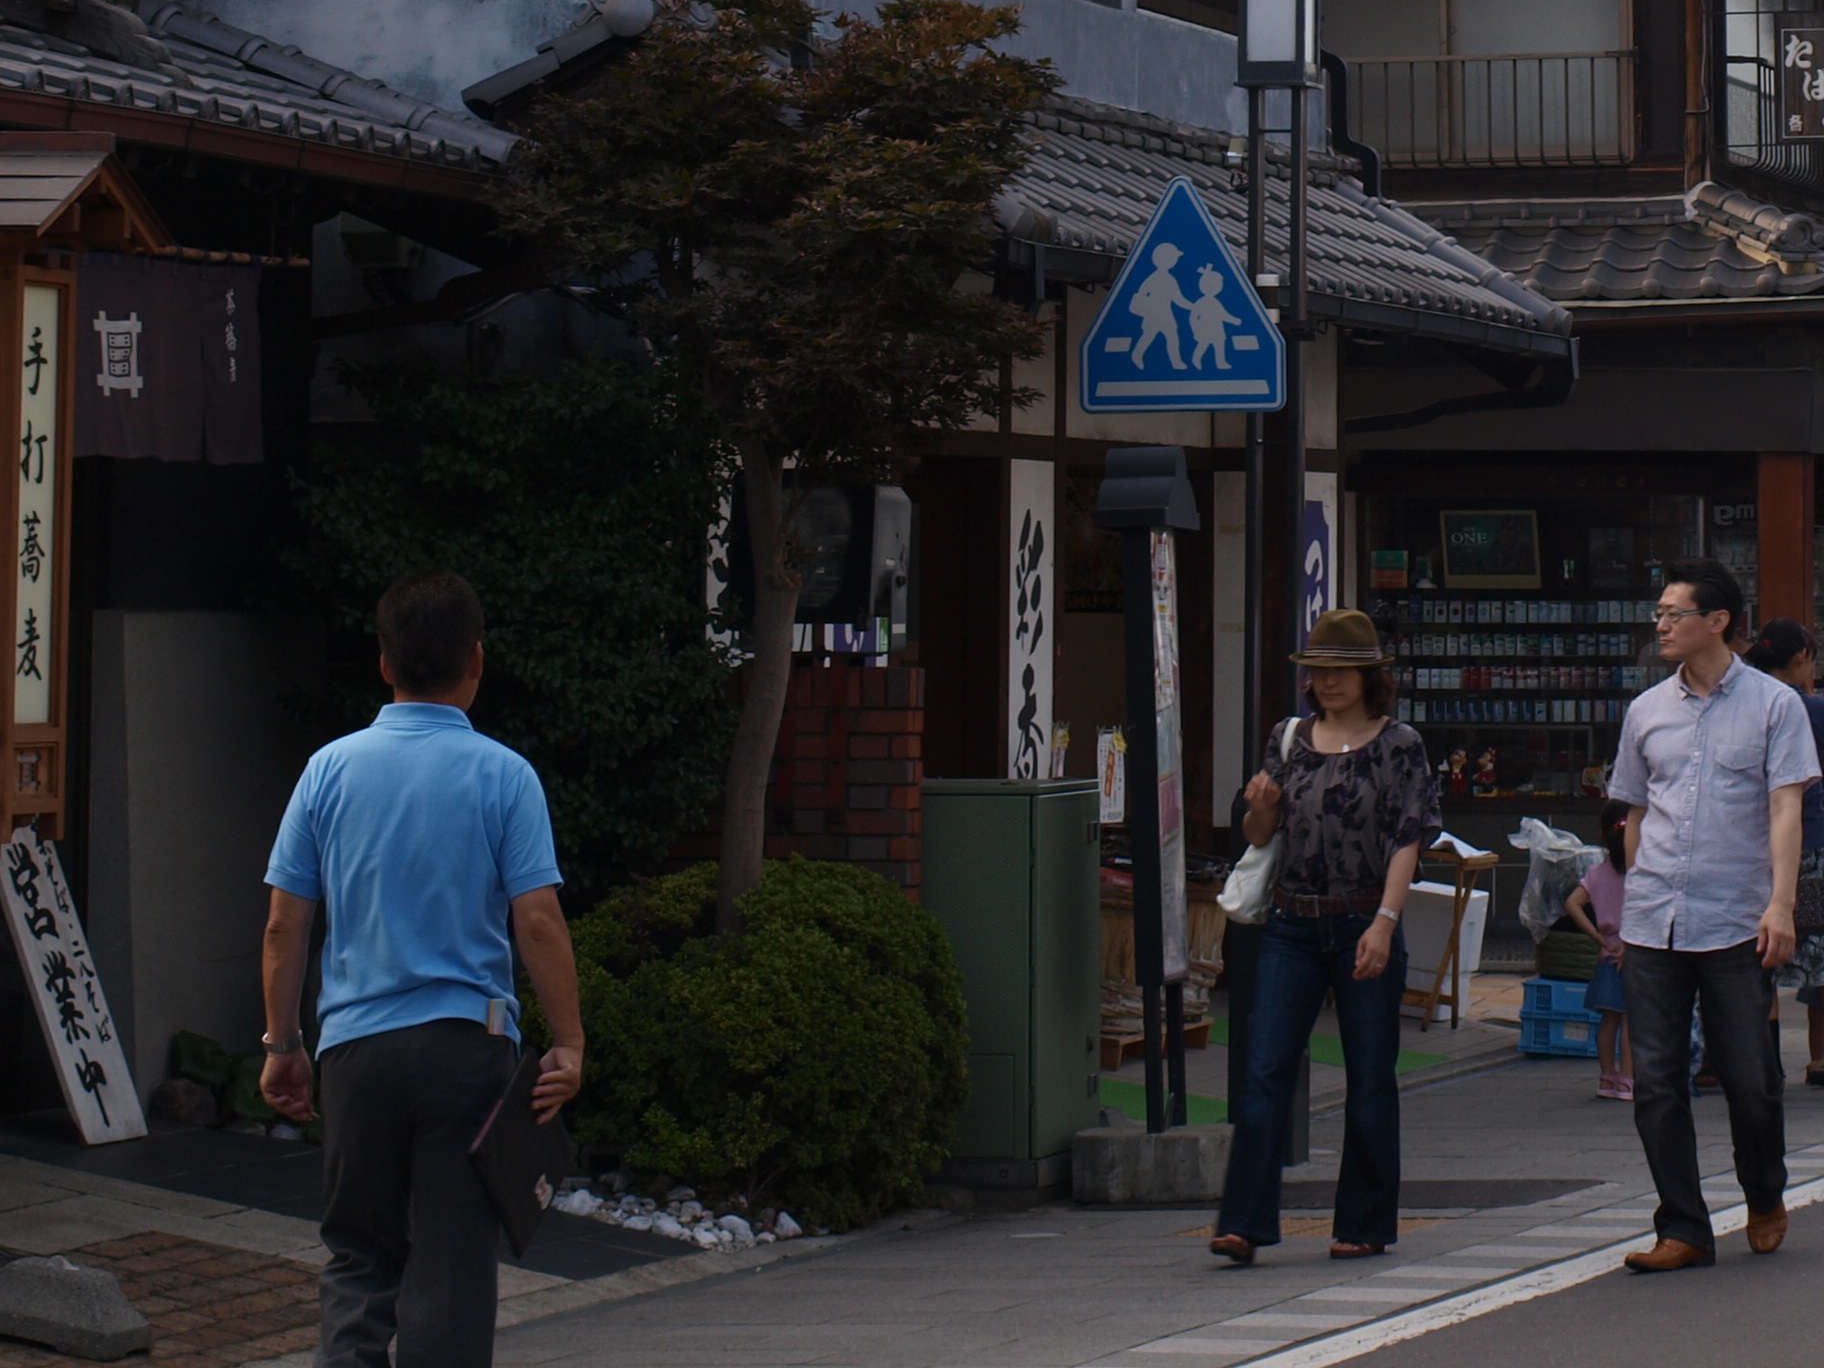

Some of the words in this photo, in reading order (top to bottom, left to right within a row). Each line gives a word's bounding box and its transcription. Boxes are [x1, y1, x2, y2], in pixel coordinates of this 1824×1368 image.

[16, 326, 48, 681] 手打蕎麦
[1451, 532, 1489, 544] ONE
[7, 841, 111, 1128] 営業中
